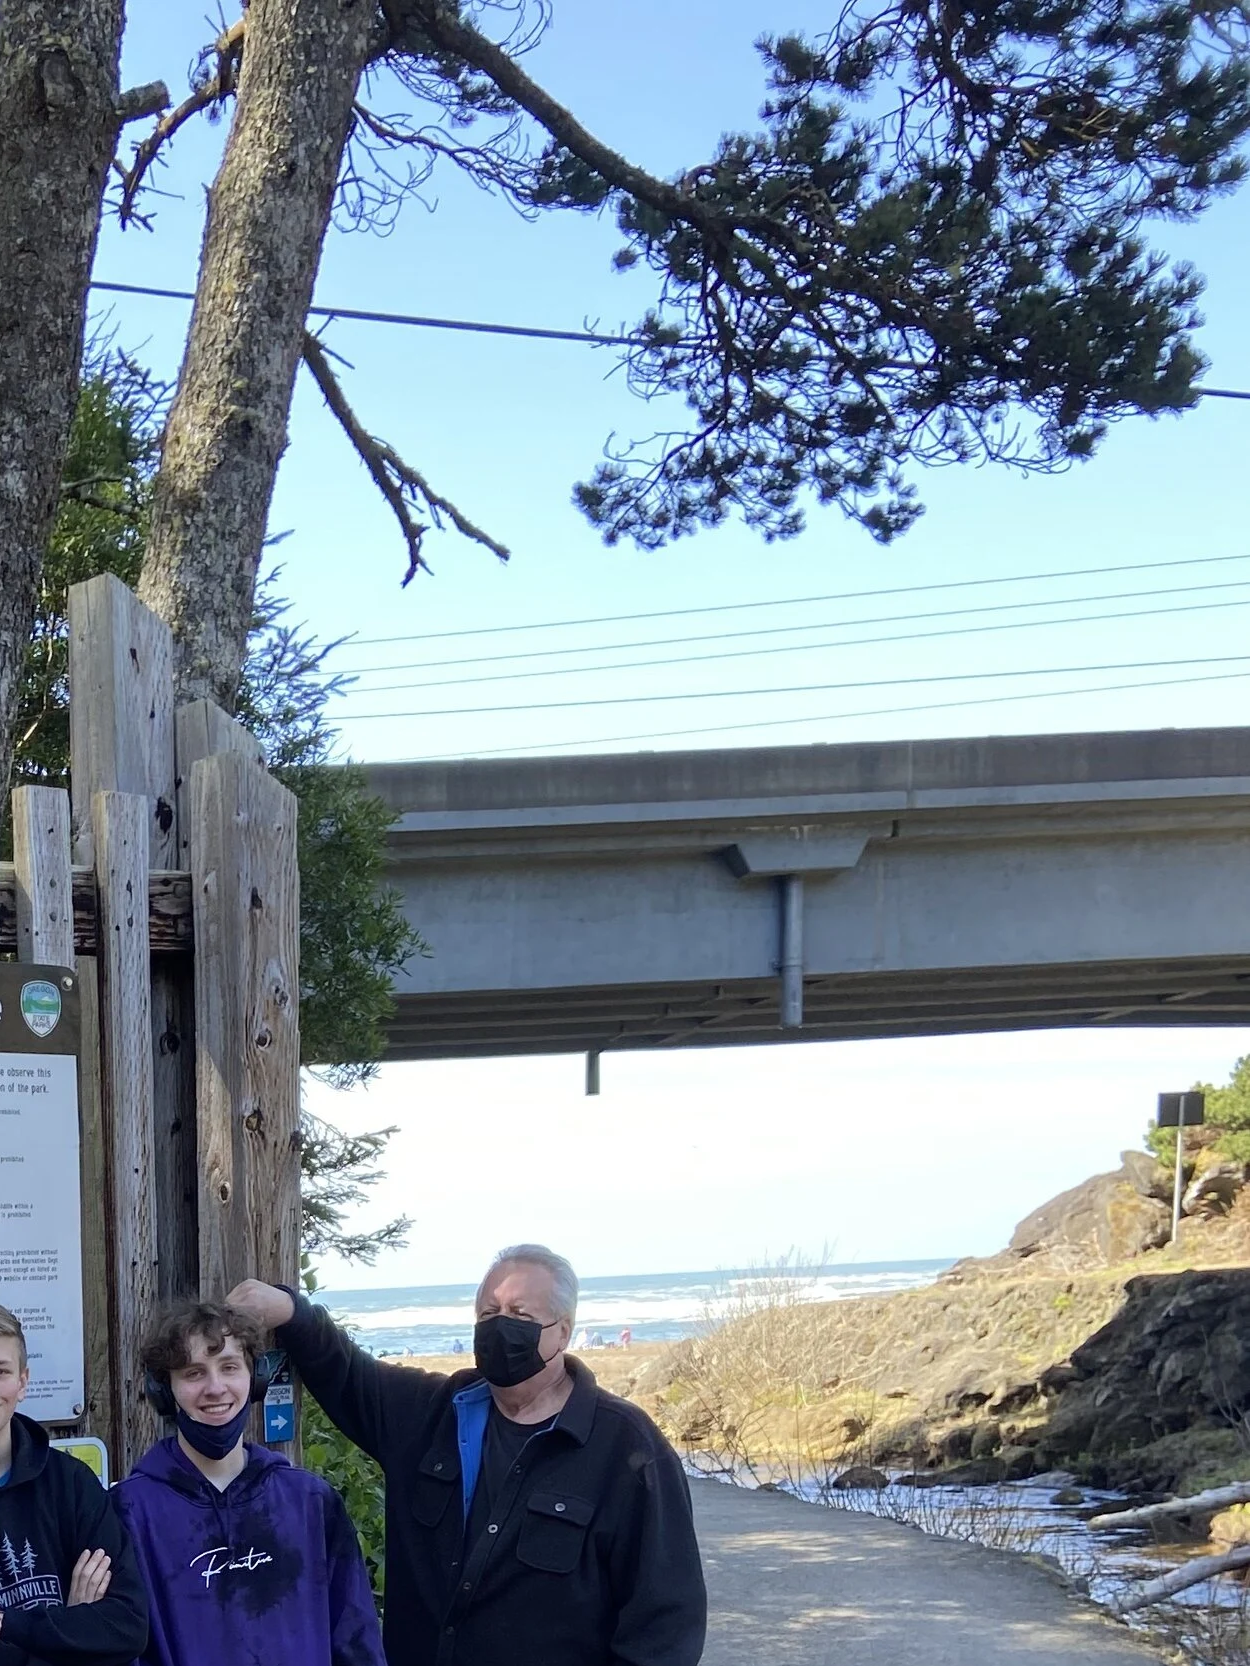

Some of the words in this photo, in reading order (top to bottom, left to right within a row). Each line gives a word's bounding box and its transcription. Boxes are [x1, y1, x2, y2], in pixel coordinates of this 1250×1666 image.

[6, 1068, 34, 1077] observe
[38, 1068, 51, 1078] this
[8, 1083, 14, 1092] of
[18, 1083, 28, 1093] the
